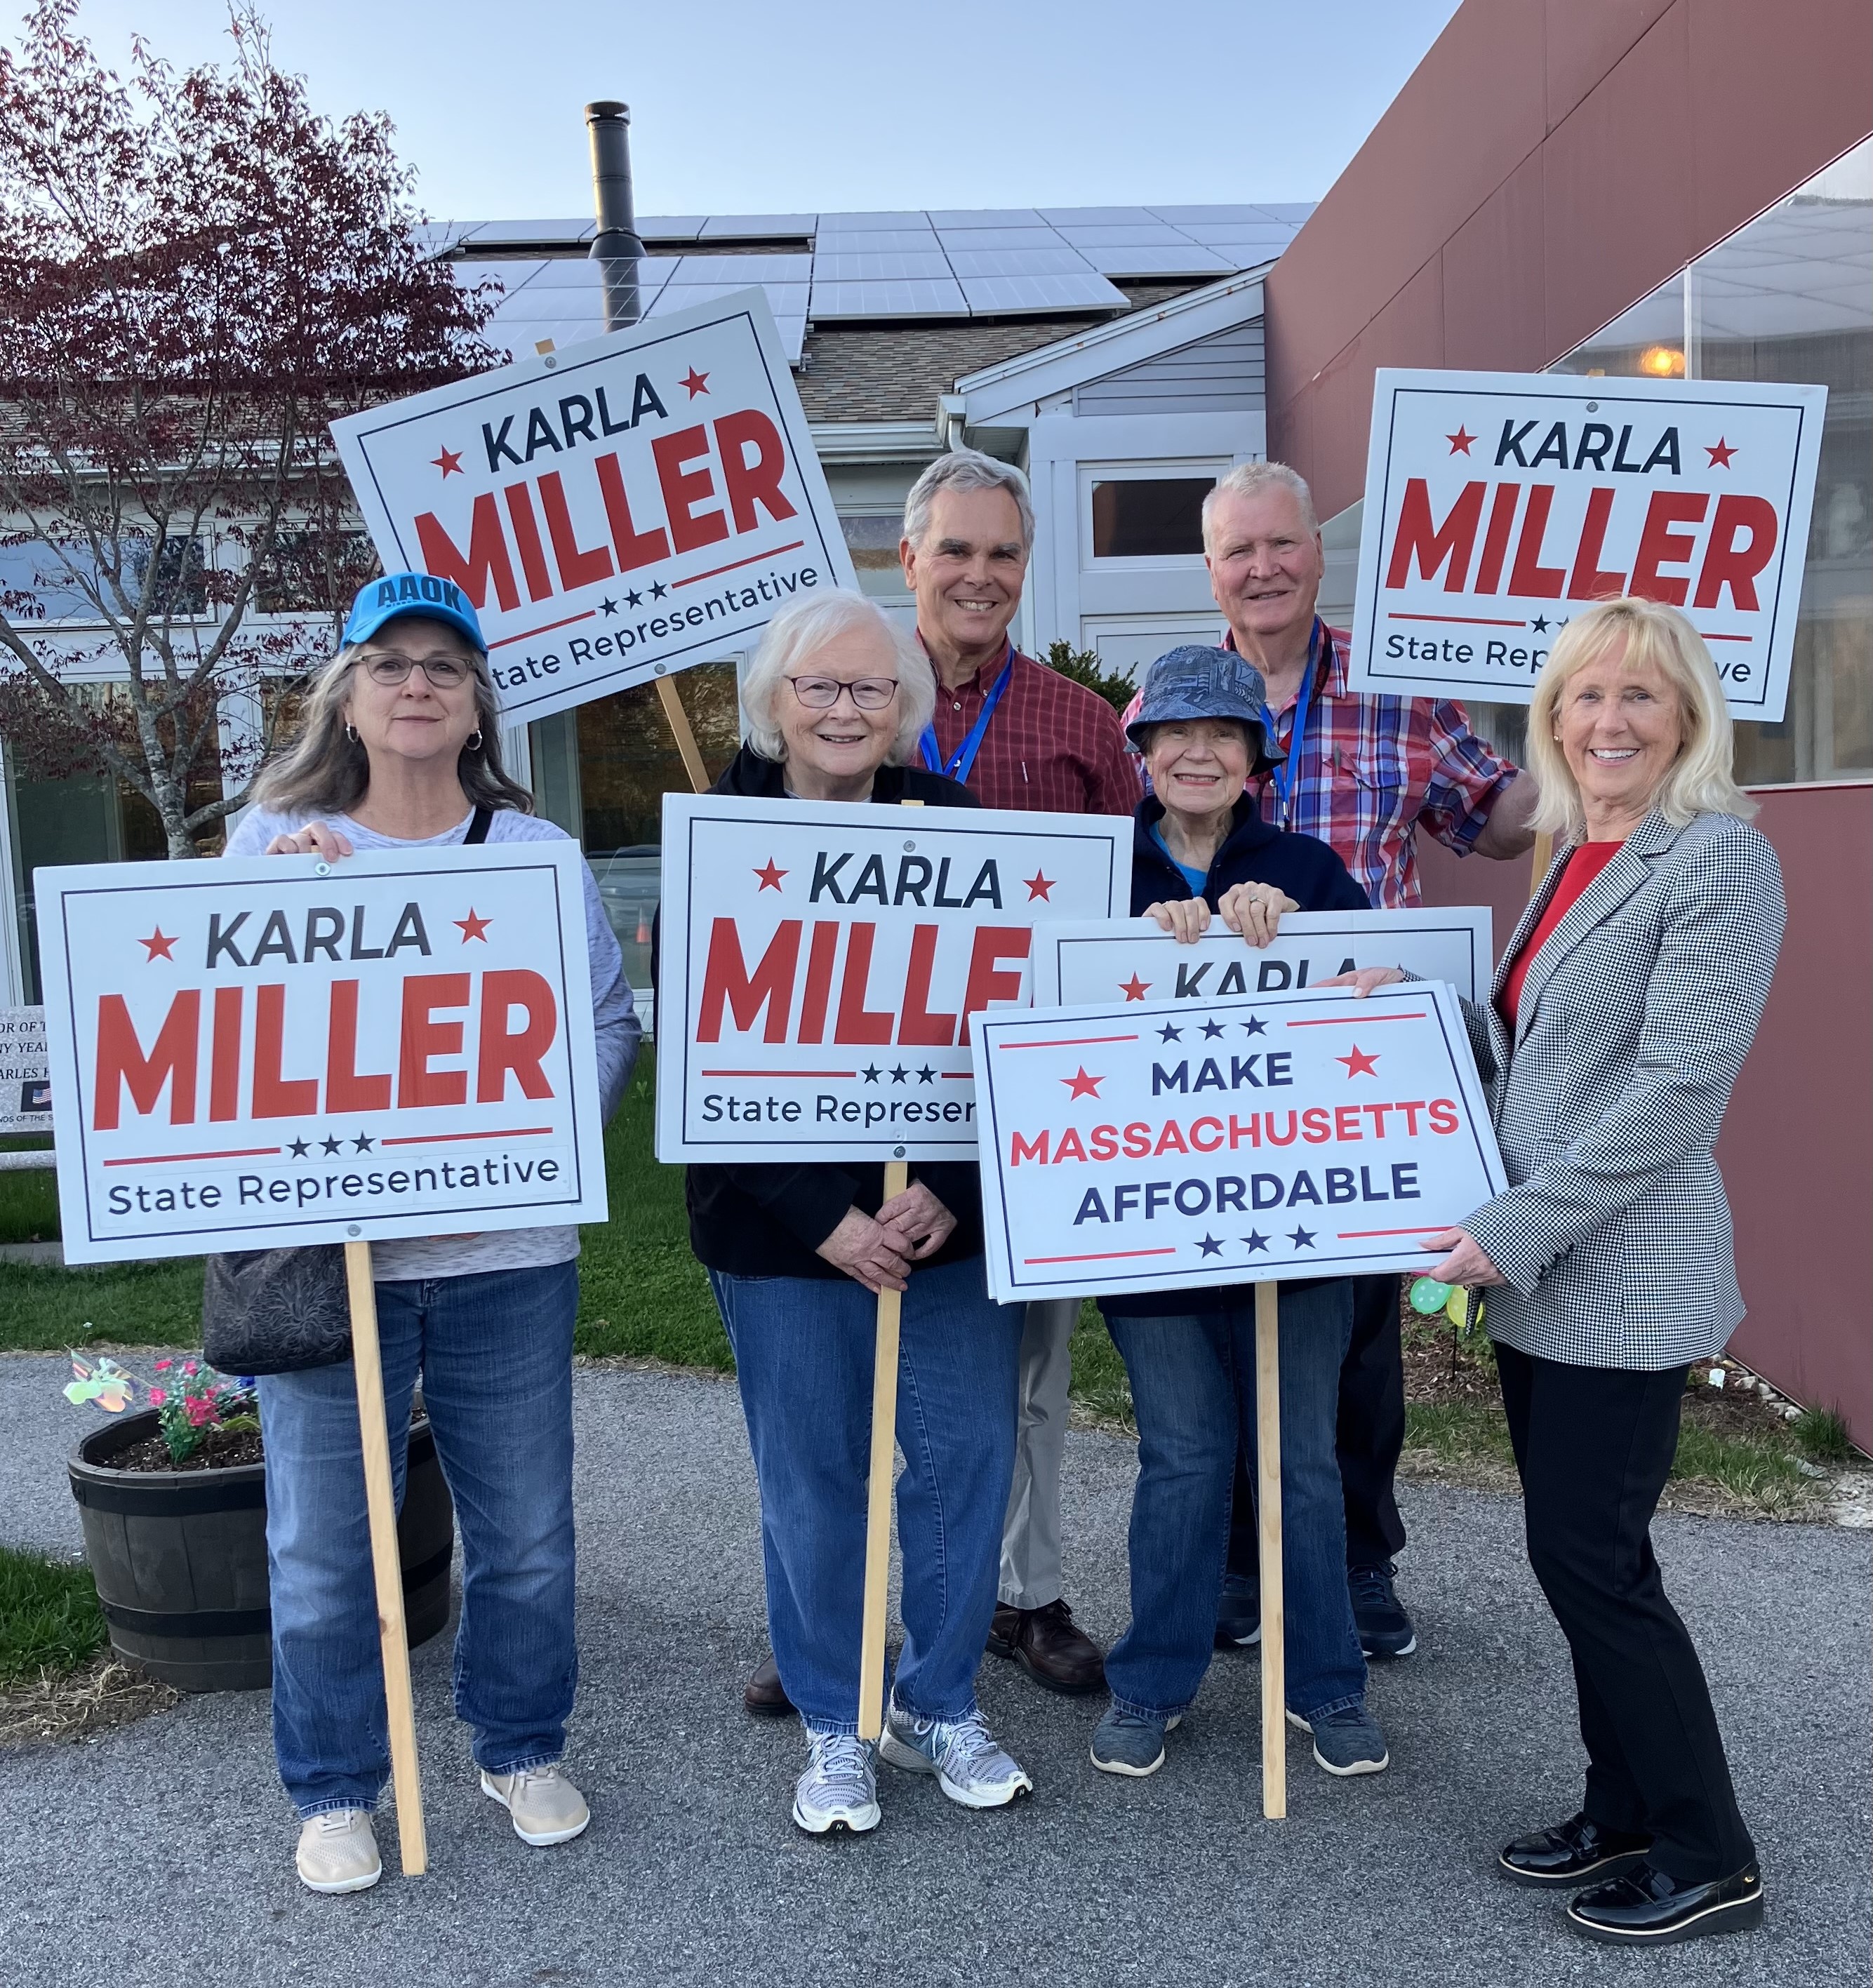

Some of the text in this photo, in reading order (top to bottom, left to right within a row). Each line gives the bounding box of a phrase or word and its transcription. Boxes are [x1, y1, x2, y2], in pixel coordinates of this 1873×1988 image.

[482, 373, 668, 473] KARLA
[1494, 419, 1681, 475] KARLA
[414, 408, 797, 613] MILLER
[1385, 478, 1778, 611] MILLER
[378, 575, 463, 614] AAOK
[492, 567, 818, 691] tate Representative
[1386, 634, 1473, 664] State
[809, 851, 1003, 909] KARLA
[206, 902, 432, 969] KARLA
[696, 916, 1033, 1046] MILLE
[18, 1042, 47, 1053] YEA
[20, 1022, 37, 1032] OF
[93, 969, 557, 1131] MILLER
[1152, 1052, 1293, 1096] MAKE
[702, 1095, 802, 1123] State
[1011, 1098, 1459, 1167] MASSACHUSETTS
[108, 1154, 559, 1215] State Representative
[1072, 1162, 1421, 1226] AFFORDABLE
